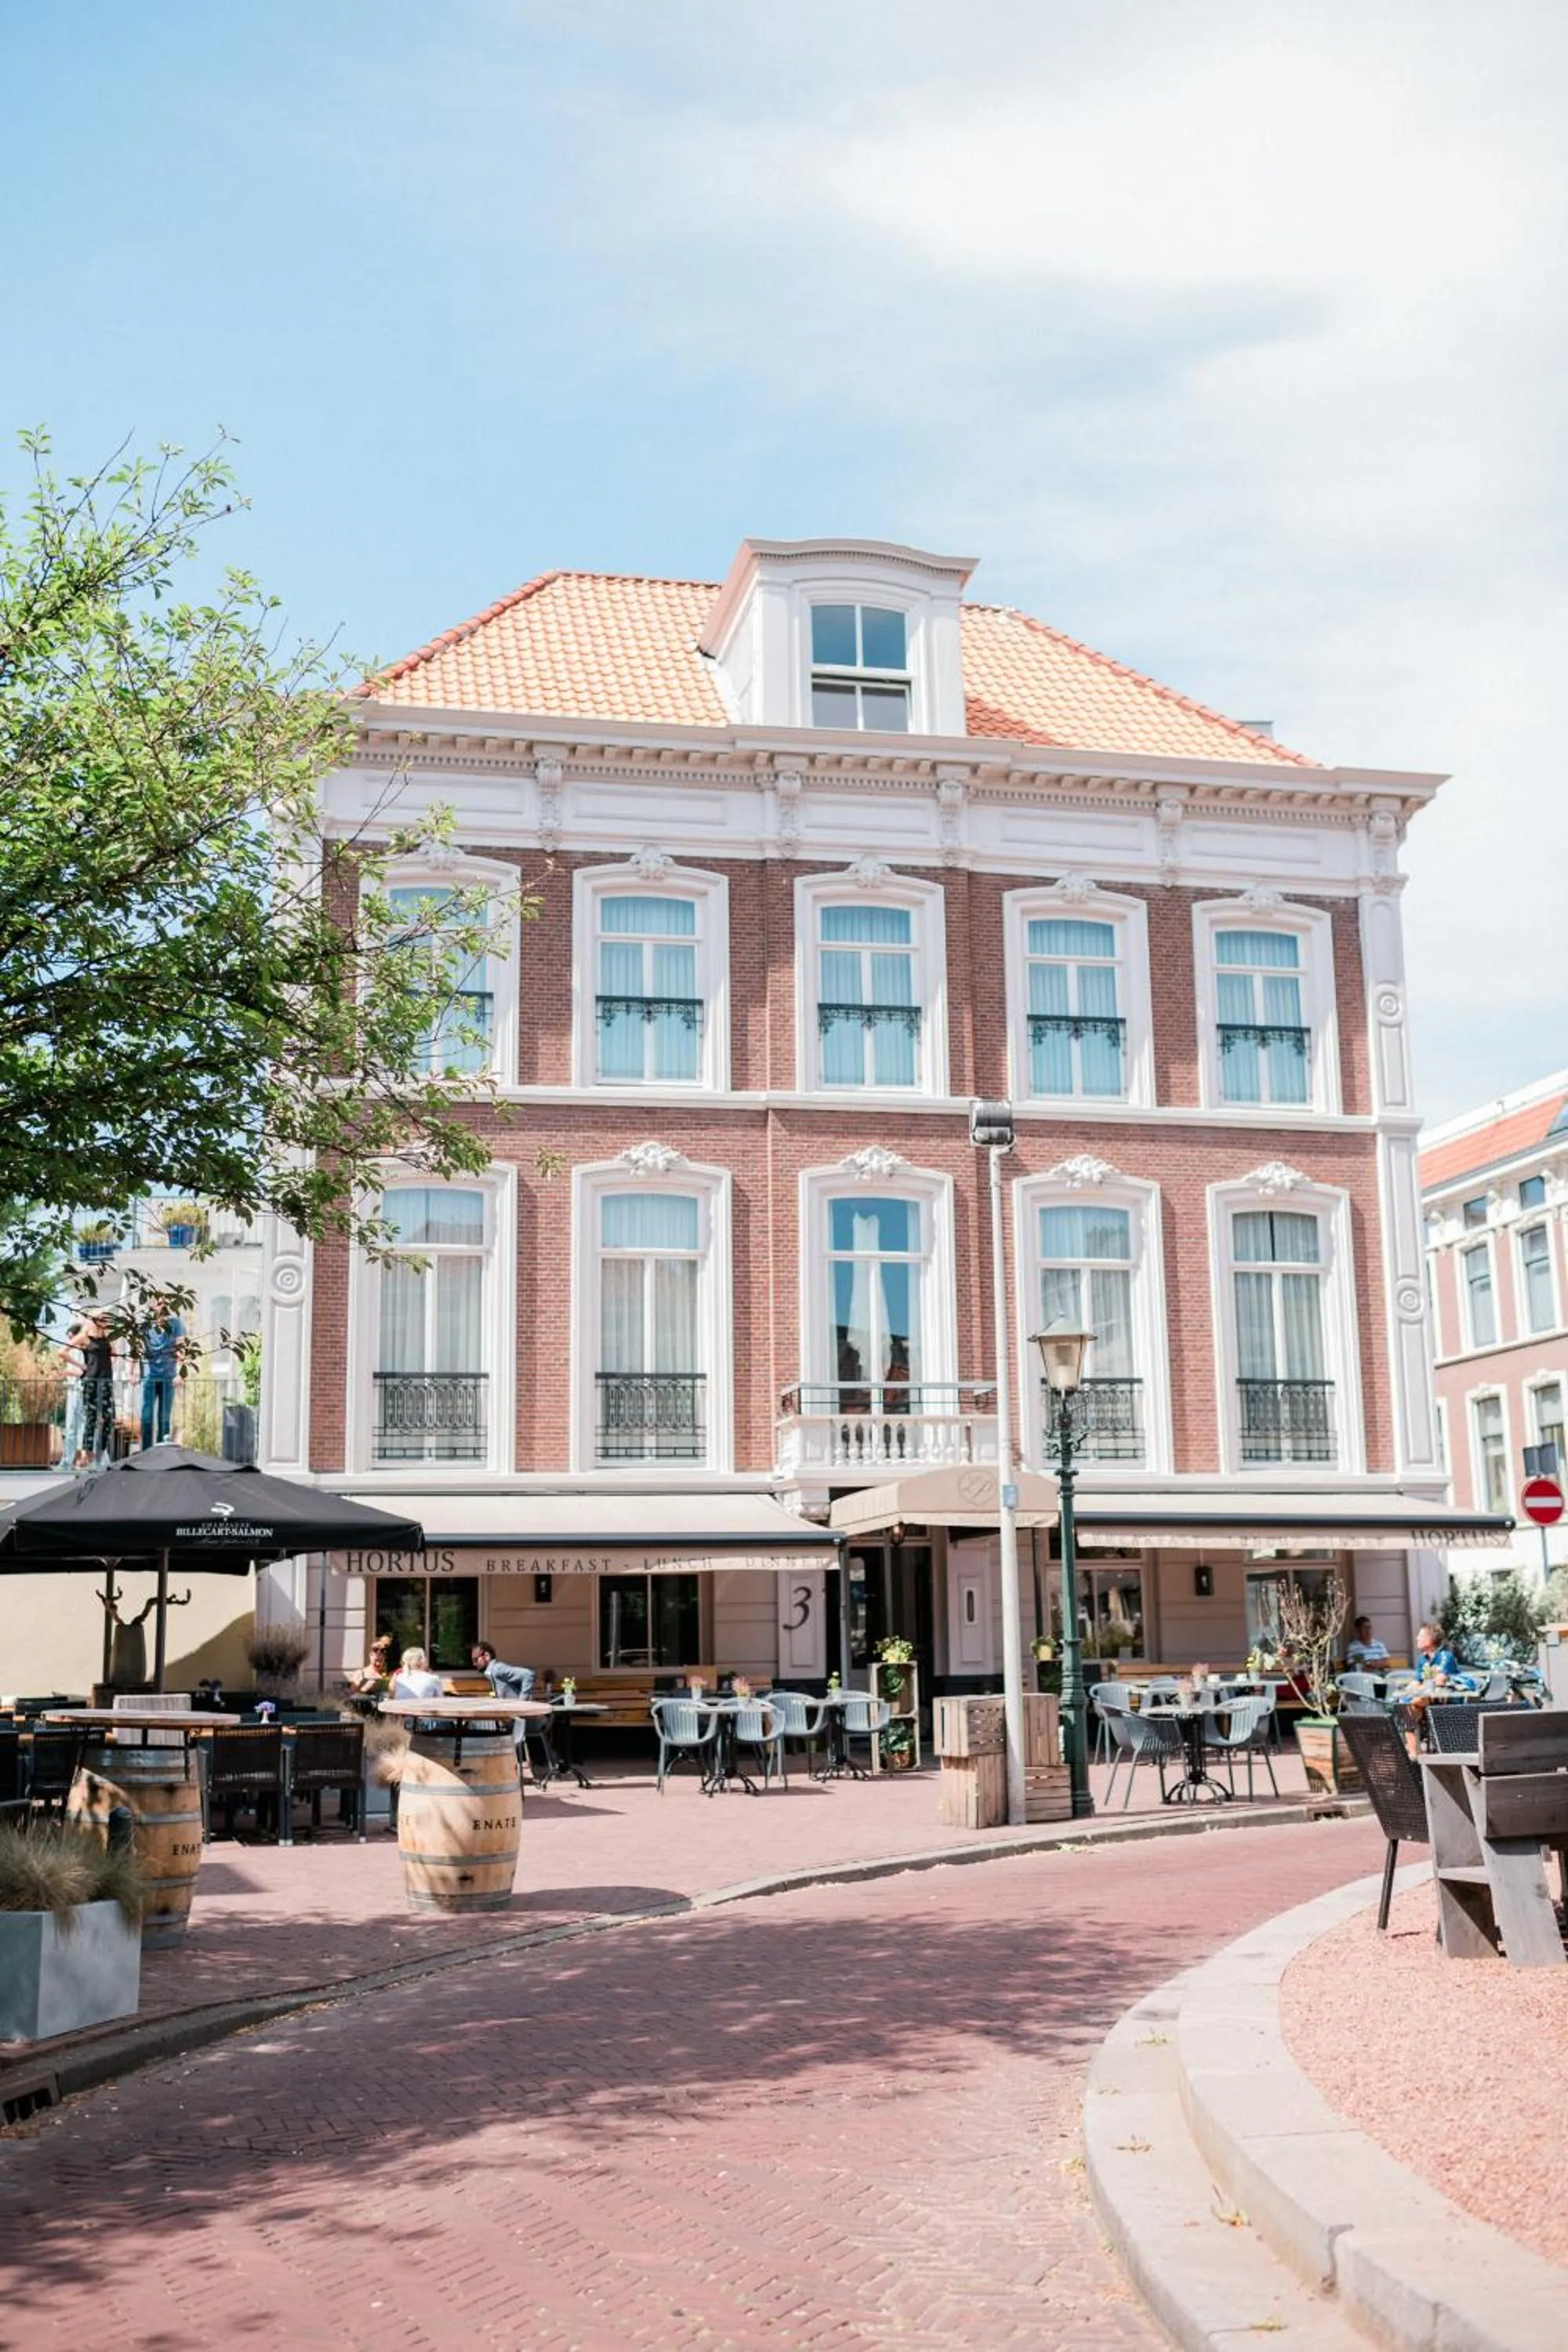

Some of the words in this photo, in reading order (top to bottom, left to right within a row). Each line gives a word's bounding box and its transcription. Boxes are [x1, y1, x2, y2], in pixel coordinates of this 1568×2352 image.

[175, 1526, 274, 1537] BILLECART-SALMON
[346, 1550, 455, 1572] HORTUS
[487, 1558, 612, 1572] BREAKFAST
[644, 1556, 713, 1570] LUNCH
[782, 1586, 812, 1630] 3
[472, 1817, 517, 1831] ENATE
